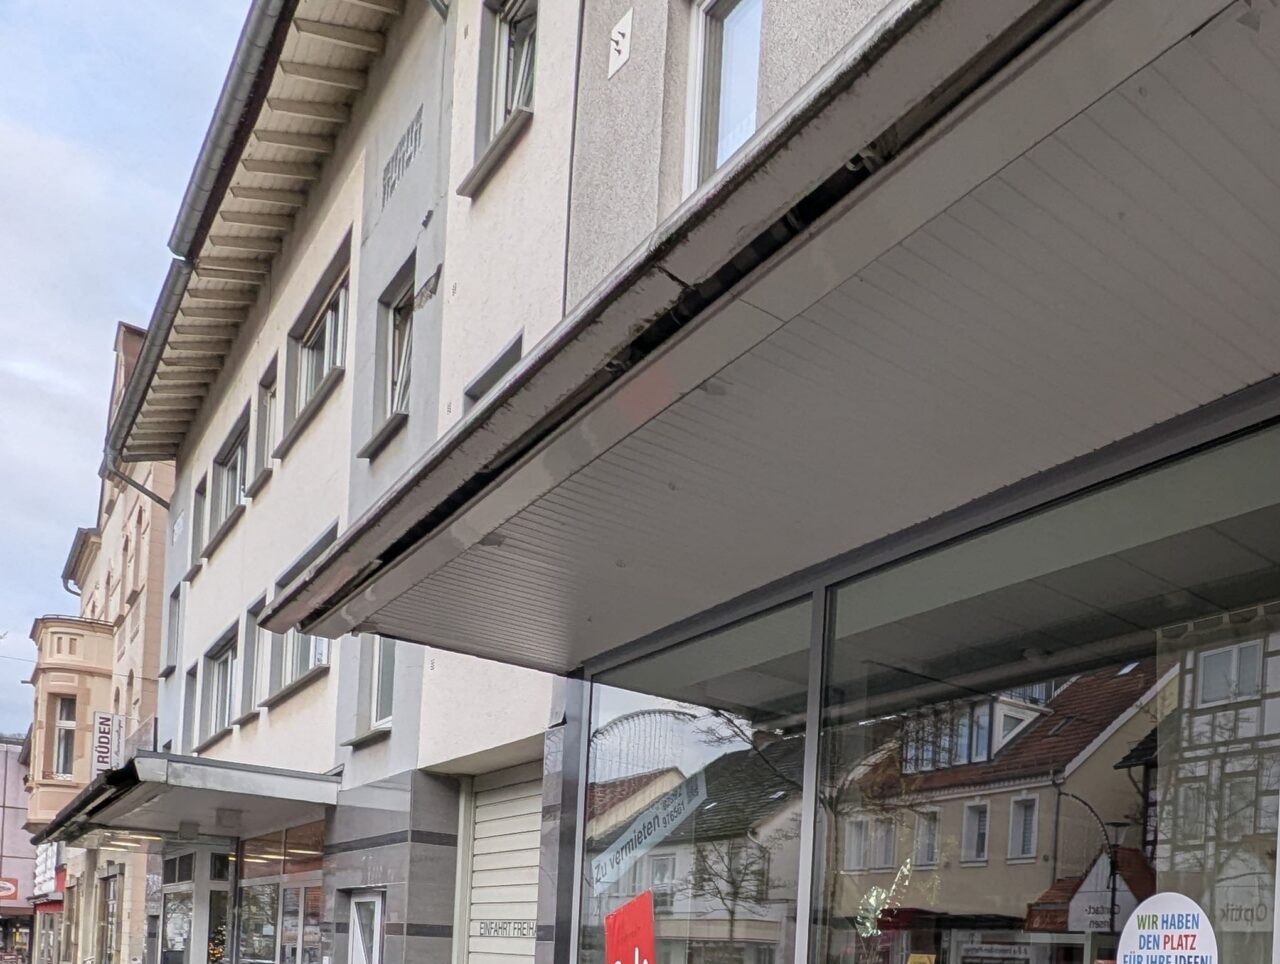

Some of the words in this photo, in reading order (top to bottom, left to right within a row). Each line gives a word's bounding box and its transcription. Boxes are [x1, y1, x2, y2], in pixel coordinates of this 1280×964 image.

[95, 716, 112, 764] RÜDEN
[594, 861, 607, 882] Zu
[609, 814, 661, 869] vermieten
[480, 921, 512, 936] EINFAHRT
[1137, 914, 1159, 930] WIR
[1161, 913, 1200, 930] HABEN
[1138, 934, 1160, 951] DEN
[1163, 934, 1197, 951] PLATZ
